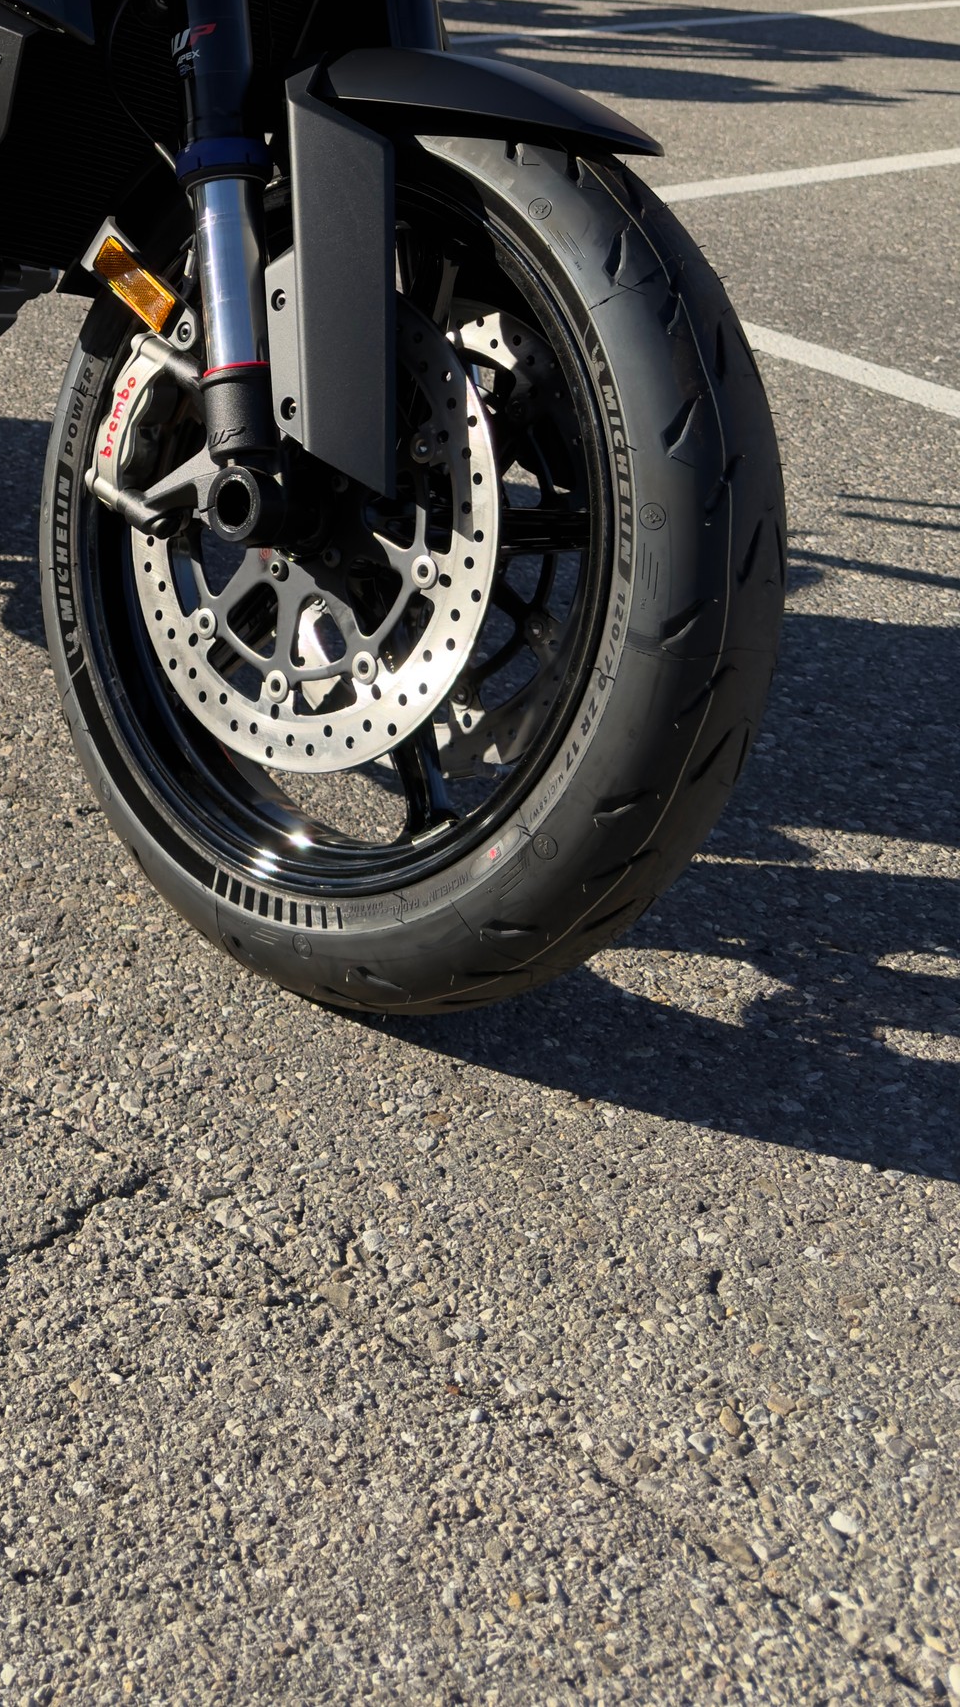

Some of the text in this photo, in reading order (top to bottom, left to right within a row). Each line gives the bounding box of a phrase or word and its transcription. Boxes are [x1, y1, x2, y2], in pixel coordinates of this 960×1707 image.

[64, 367, 94, 458] POWER
[100, 377, 136, 458] brembo
[602, 384, 632, 565] MICHELIN
[56, 475, 75, 622] MICHELIN
[597, 592, 626, 692] 120/70
